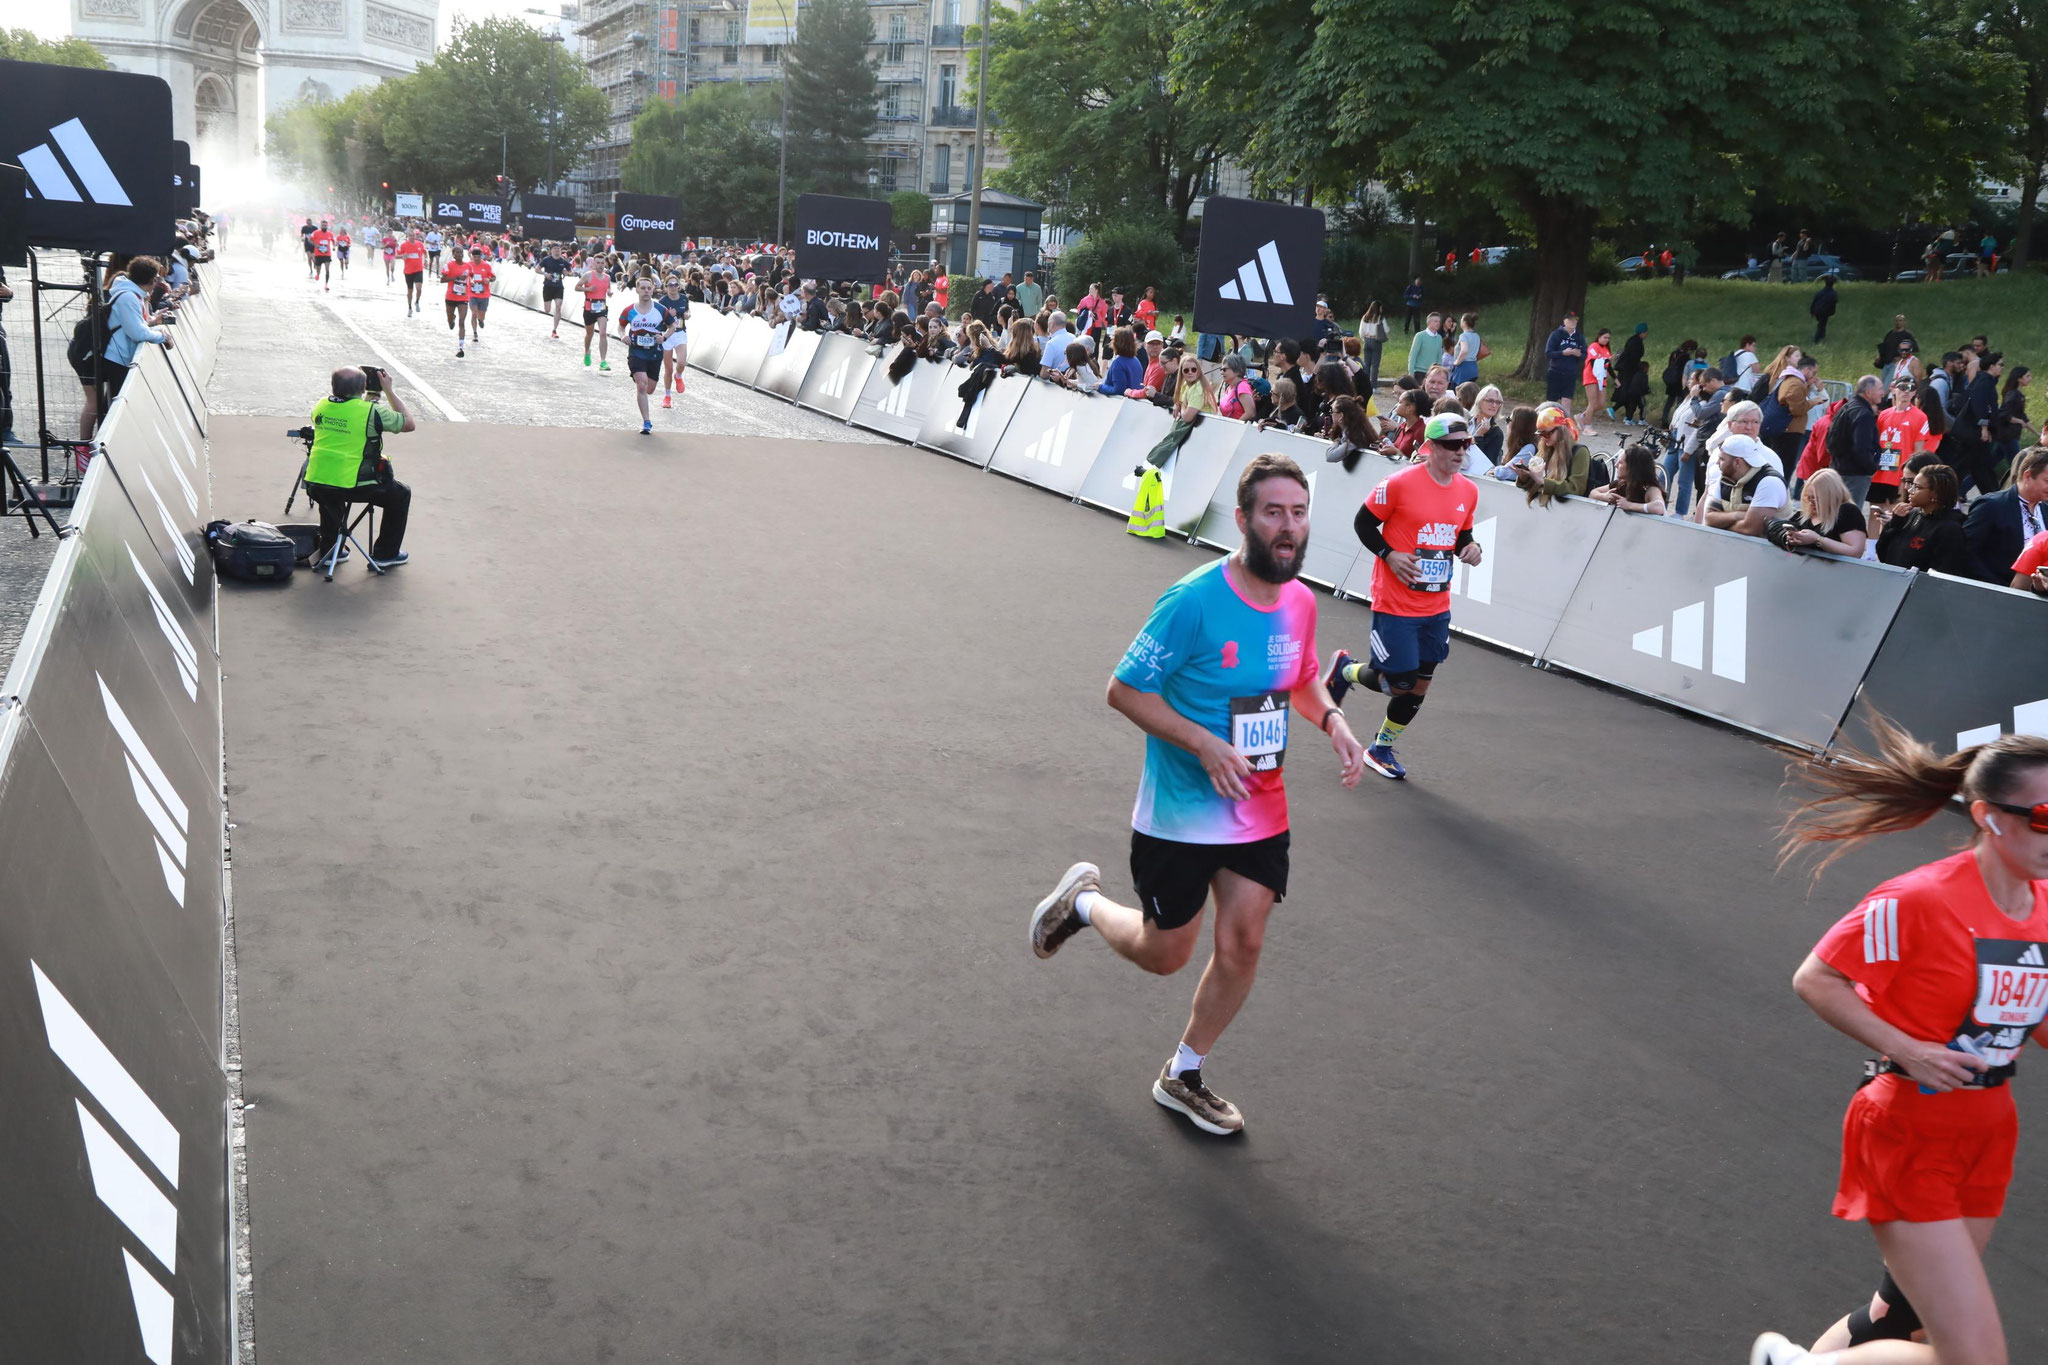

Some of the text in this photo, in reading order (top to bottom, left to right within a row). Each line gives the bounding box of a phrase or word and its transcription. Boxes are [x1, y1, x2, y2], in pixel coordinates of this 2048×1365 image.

[469, 203, 502, 213] POWER
[621, 214, 675, 231] Compeed
[806, 229, 879, 251] BIOTHERM
[1416, 532, 1456, 547] PARIS
[1421, 560, 1447, 576] 13591
[1242, 718, 1280, 748] 16146
[1989, 969, 2048, 1008] 18477
